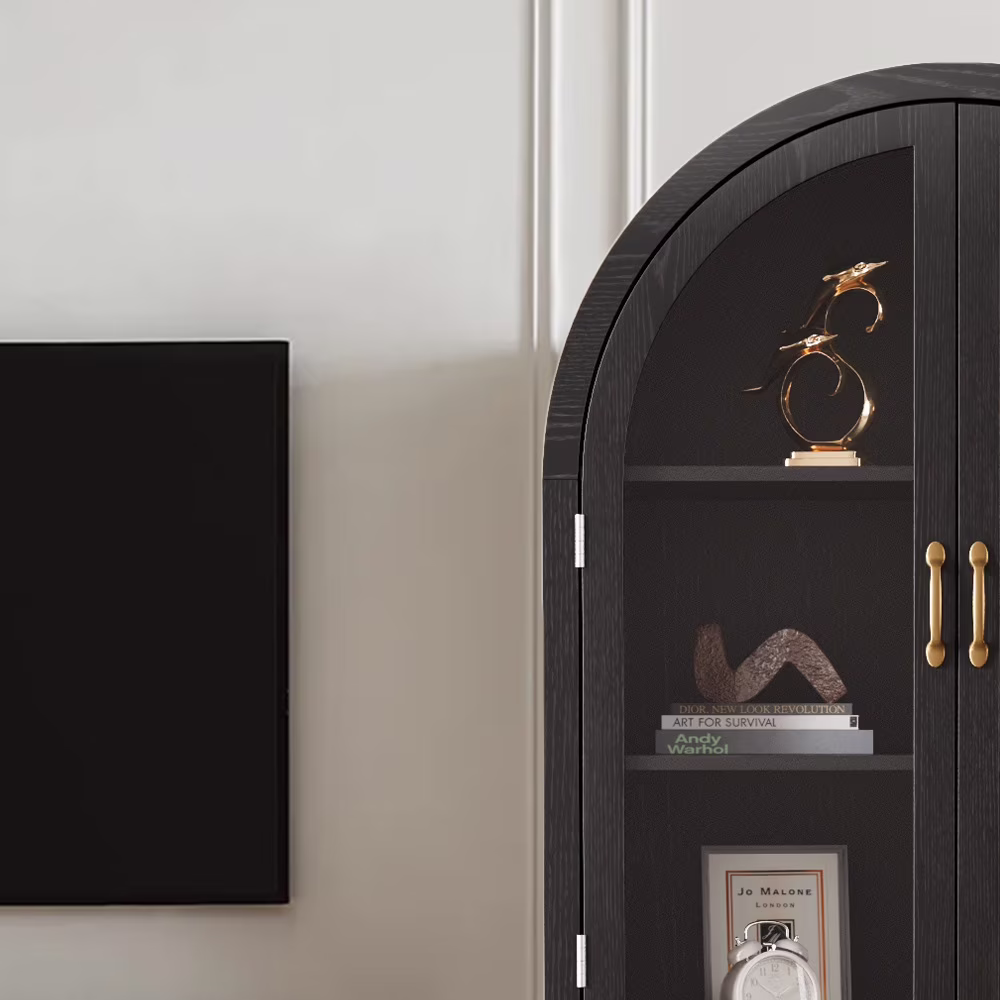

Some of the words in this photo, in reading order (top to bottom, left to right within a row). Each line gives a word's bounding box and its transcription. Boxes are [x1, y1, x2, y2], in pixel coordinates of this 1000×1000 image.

[712, 705, 737, 714] NEW
[740, 705, 771, 714] LOOK
[773, 704, 846, 714] REVOLUTION
[672, 717, 694, 727] ART
[698, 717, 722, 727] FOR
[725, 717, 777, 728] SURVIVAL
[675, 733, 722, 746] Andy
[667, 744, 729, 755] Warhol
